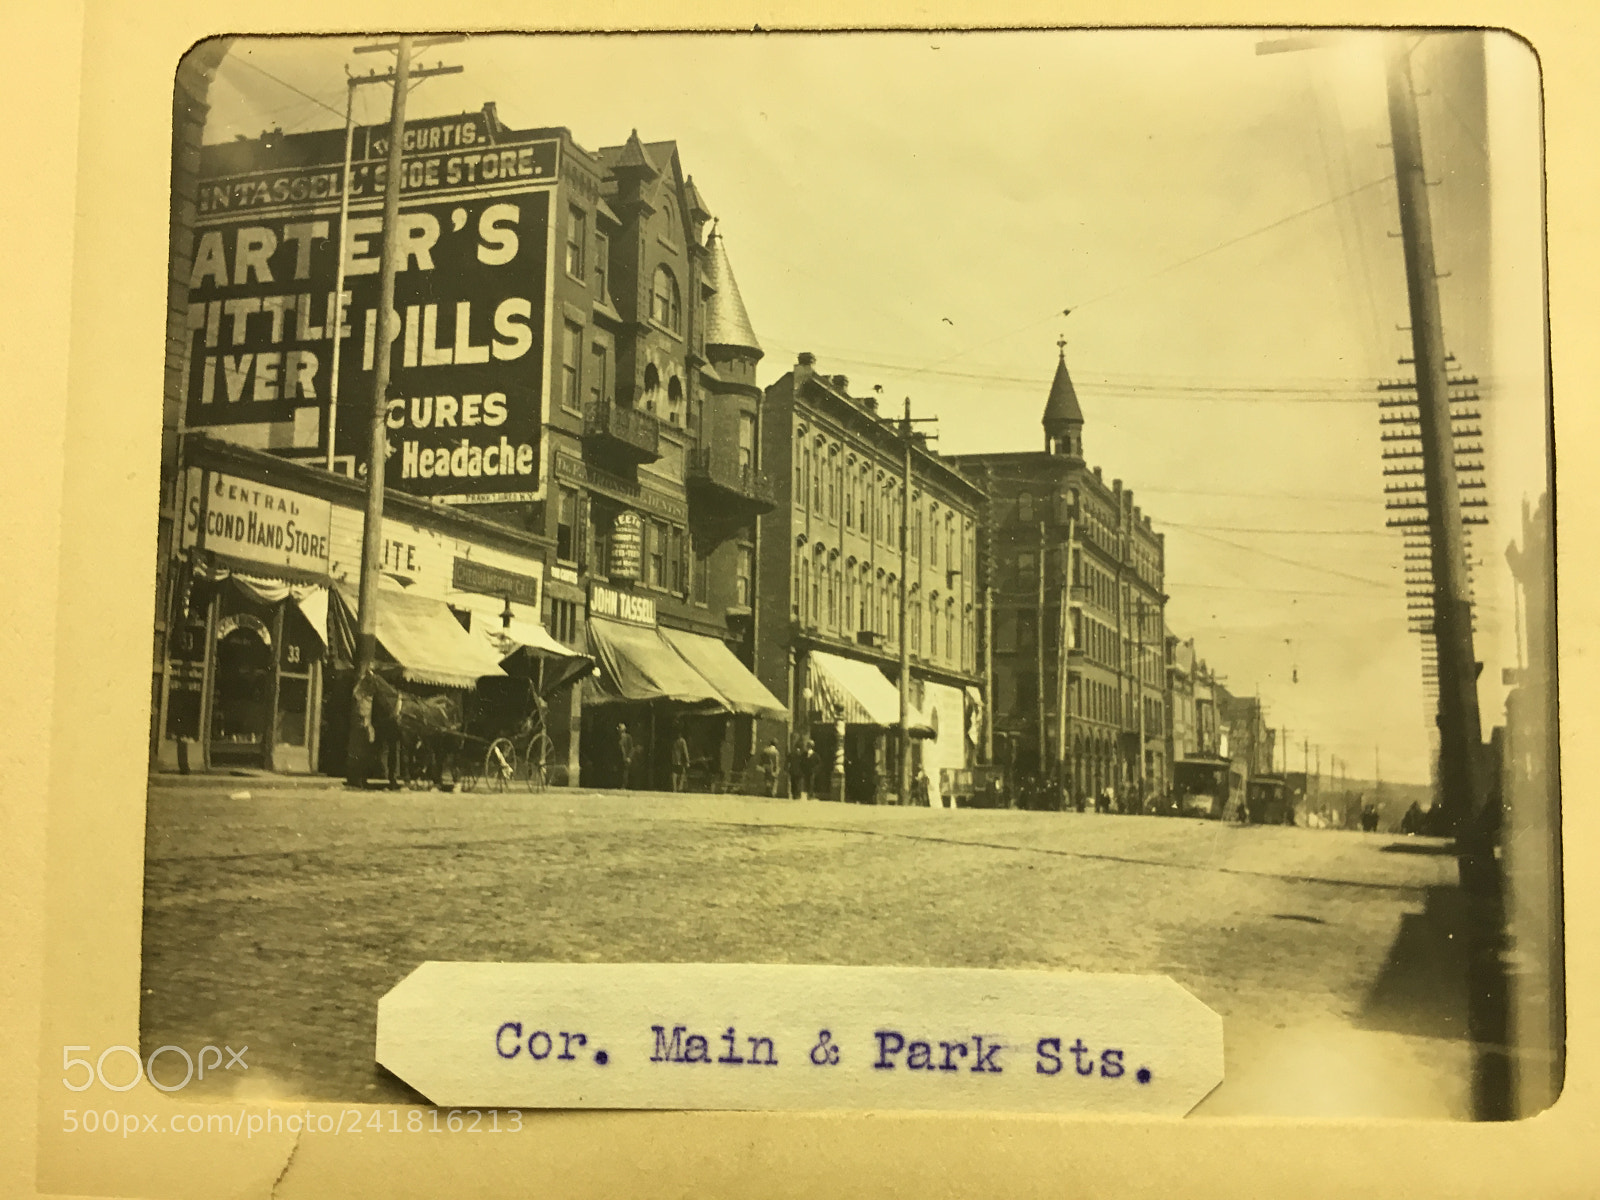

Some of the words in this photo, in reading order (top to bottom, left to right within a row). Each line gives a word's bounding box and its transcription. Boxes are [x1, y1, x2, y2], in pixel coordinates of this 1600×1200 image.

[403, 122, 486, 151] CURTIS.
[446, 147, 543, 185] STORE.
[387, 393, 508, 429] CURES
[402, 437, 533, 478] Headache
[214, 478, 300, 516] CENTRAL
[187, 497, 245, 540] SCOND
[246, 511, 284, 550] HAND
[285, 520, 329, 560] STORE
[380, 538, 423, 573] ITE.
[590, 585, 618, 618] JOHN
[495, 1022, 611, 1066] Cor.
[649, 1024, 779, 1067] Main
[810, 1030, 841, 1067] &
[873, 1031, 1004, 1073] Park
[1035, 1037, 1154, 1085] Sts.
